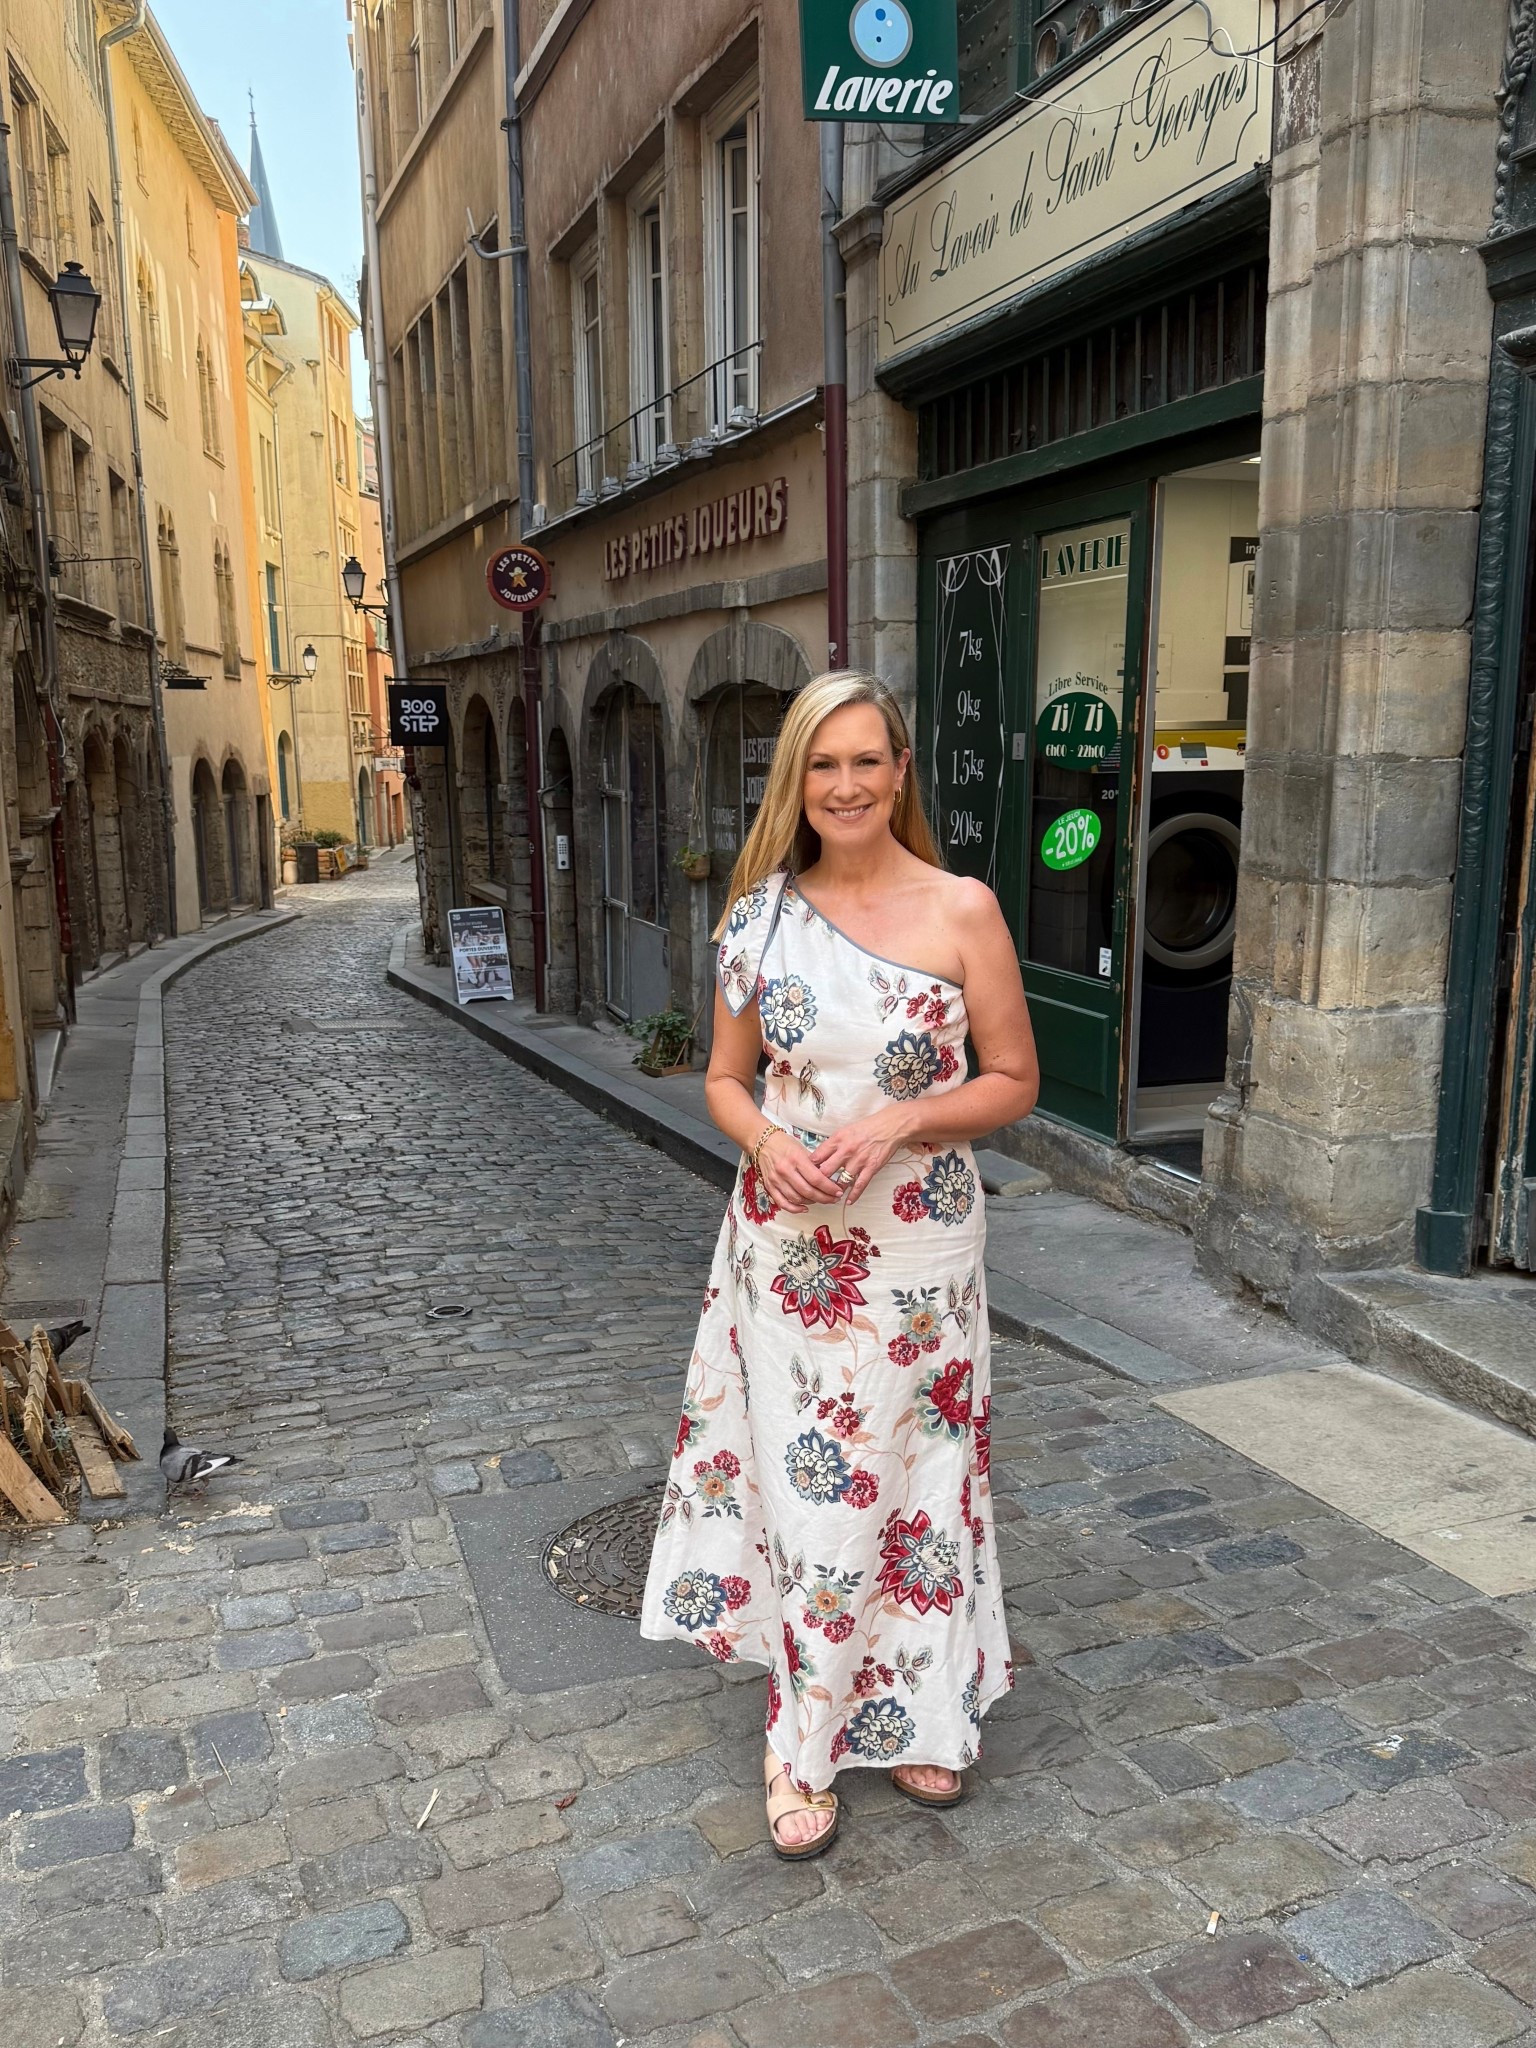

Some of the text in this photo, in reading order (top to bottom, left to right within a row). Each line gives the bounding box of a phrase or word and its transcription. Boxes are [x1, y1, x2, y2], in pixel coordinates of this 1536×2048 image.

[814, 65, 954, 115] Laverie
[888, 37, 1250, 306] Au Lavoir de Saint Georges
[604, 477, 789, 582] LES PETITS JOUEURS
[496, 553, 540, 572] LES PETITS
[1042, 532, 1128, 580] LAVERIE
[500, 587, 539, 603] JOUEURS
[959, 630, 983, 668] 7kg
[1047, 671, 1109, 698] Libre Service
[399, 715, 439, 732] STEP
[400, 699, 437, 714] BOO
[957, 690, 981, 727] 9kg
[952, 749, 985, 785] 15kg
[1045, 744, 1067, 757] 6h00
[1077, 744, 1106, 758] 22h00
[950, 810, 983, 846] 20kg
